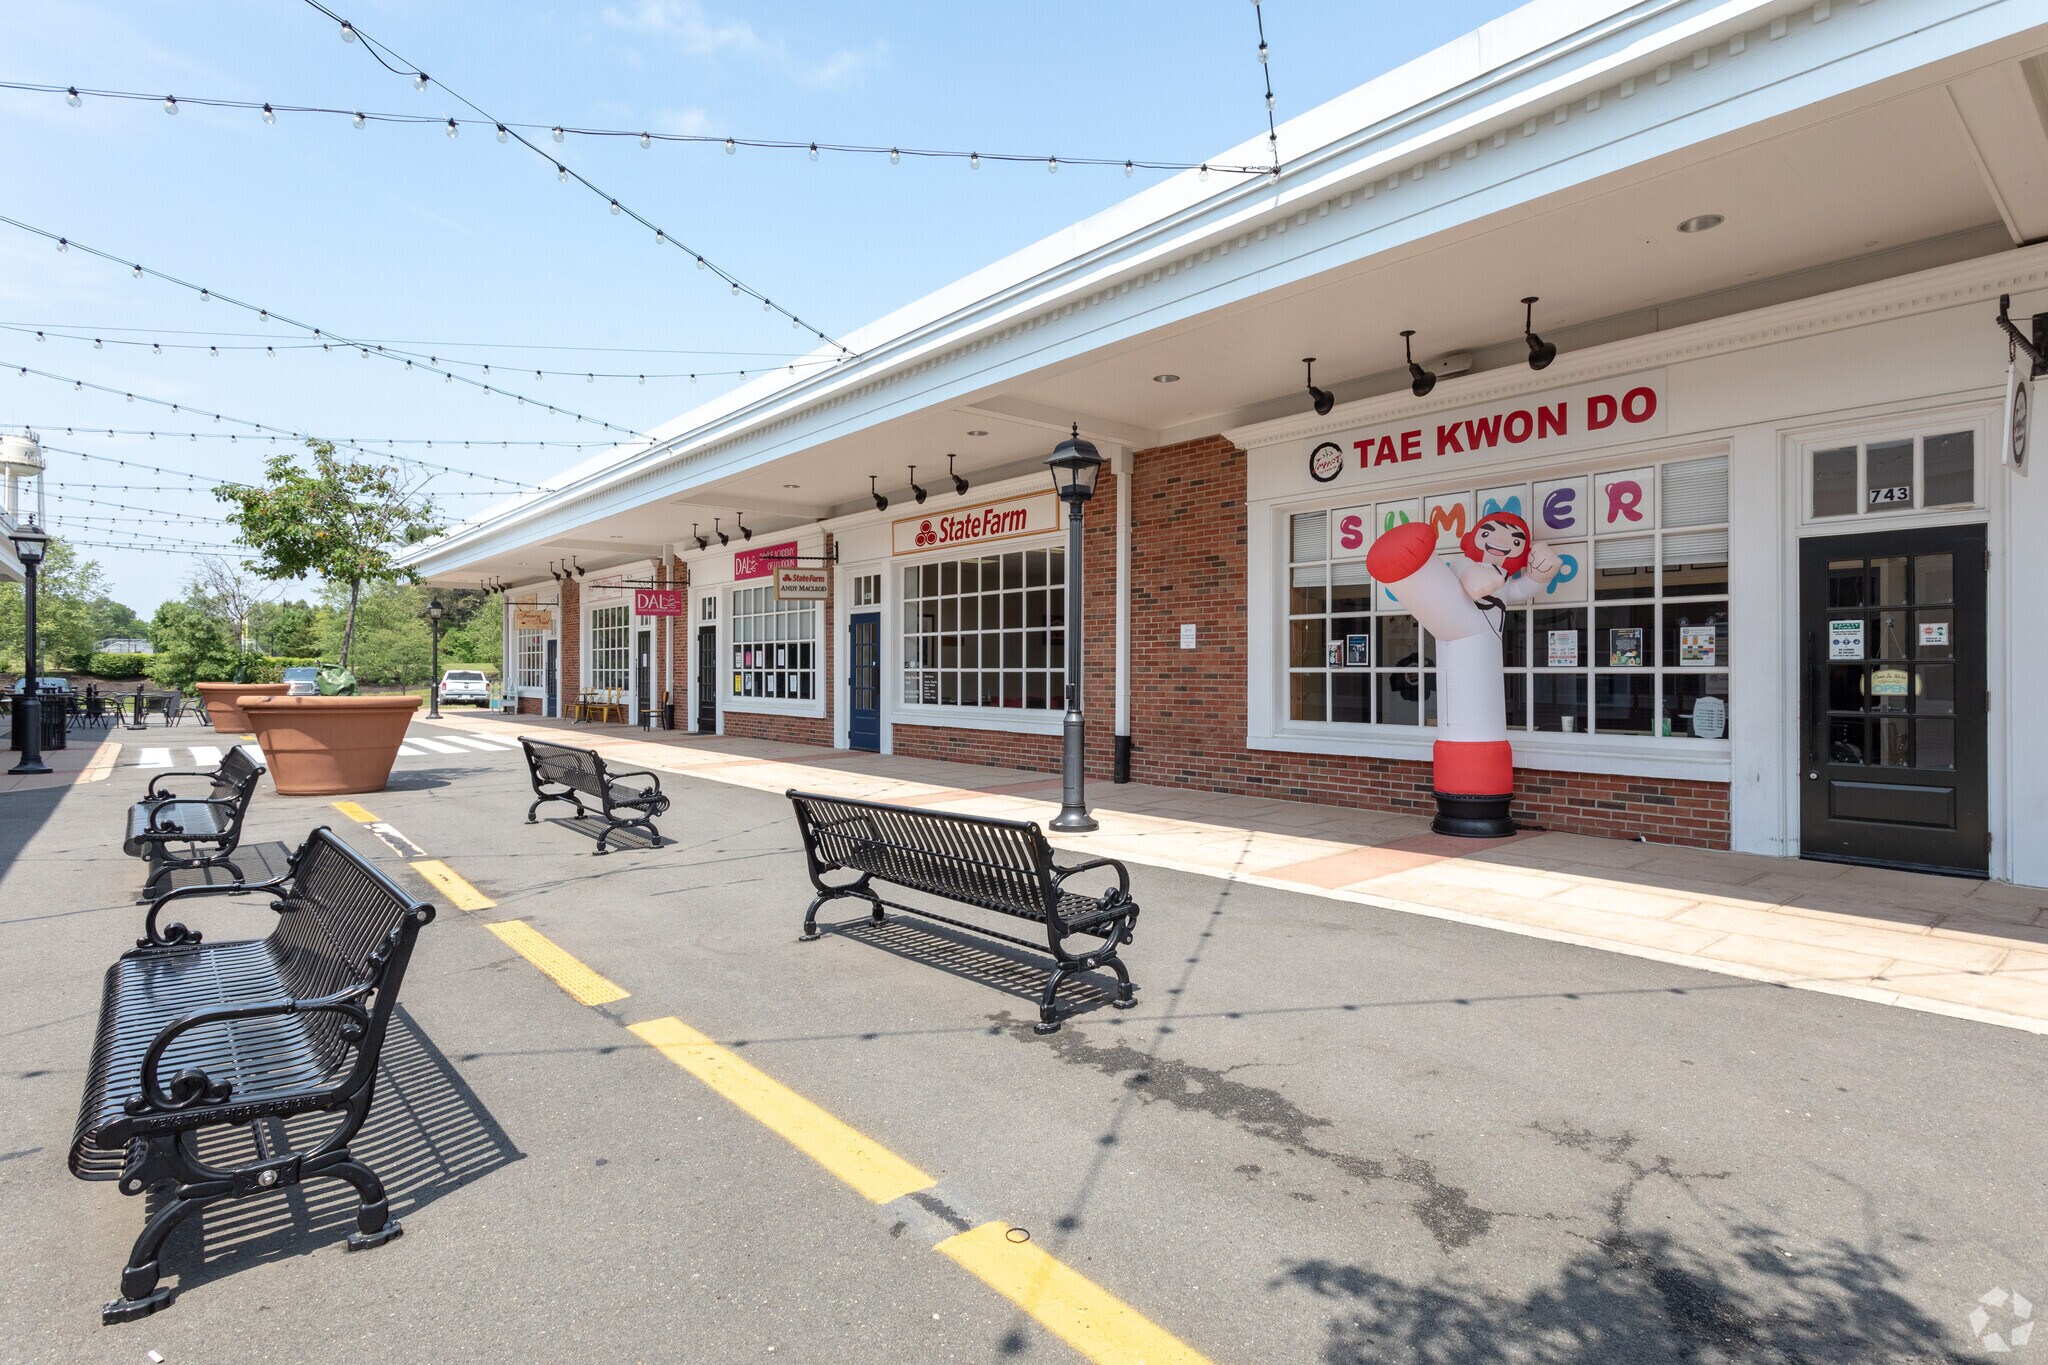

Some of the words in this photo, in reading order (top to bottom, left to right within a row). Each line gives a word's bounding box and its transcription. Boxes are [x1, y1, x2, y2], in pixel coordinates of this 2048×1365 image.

[1353, 429, 1422, 469] TAE
[1436, 402, 1568, 456] KWON
[1587, 386, 1658, 431] DO
[1871, 487, 1908, 503] 743
[637, 593, 668, 609] DAL
[149, 1110, 217, 1128] KEYSTONE
[224, 1104, 261, 1117] RIDGE
[268, 1096, 317, 1111] DESIGNS
